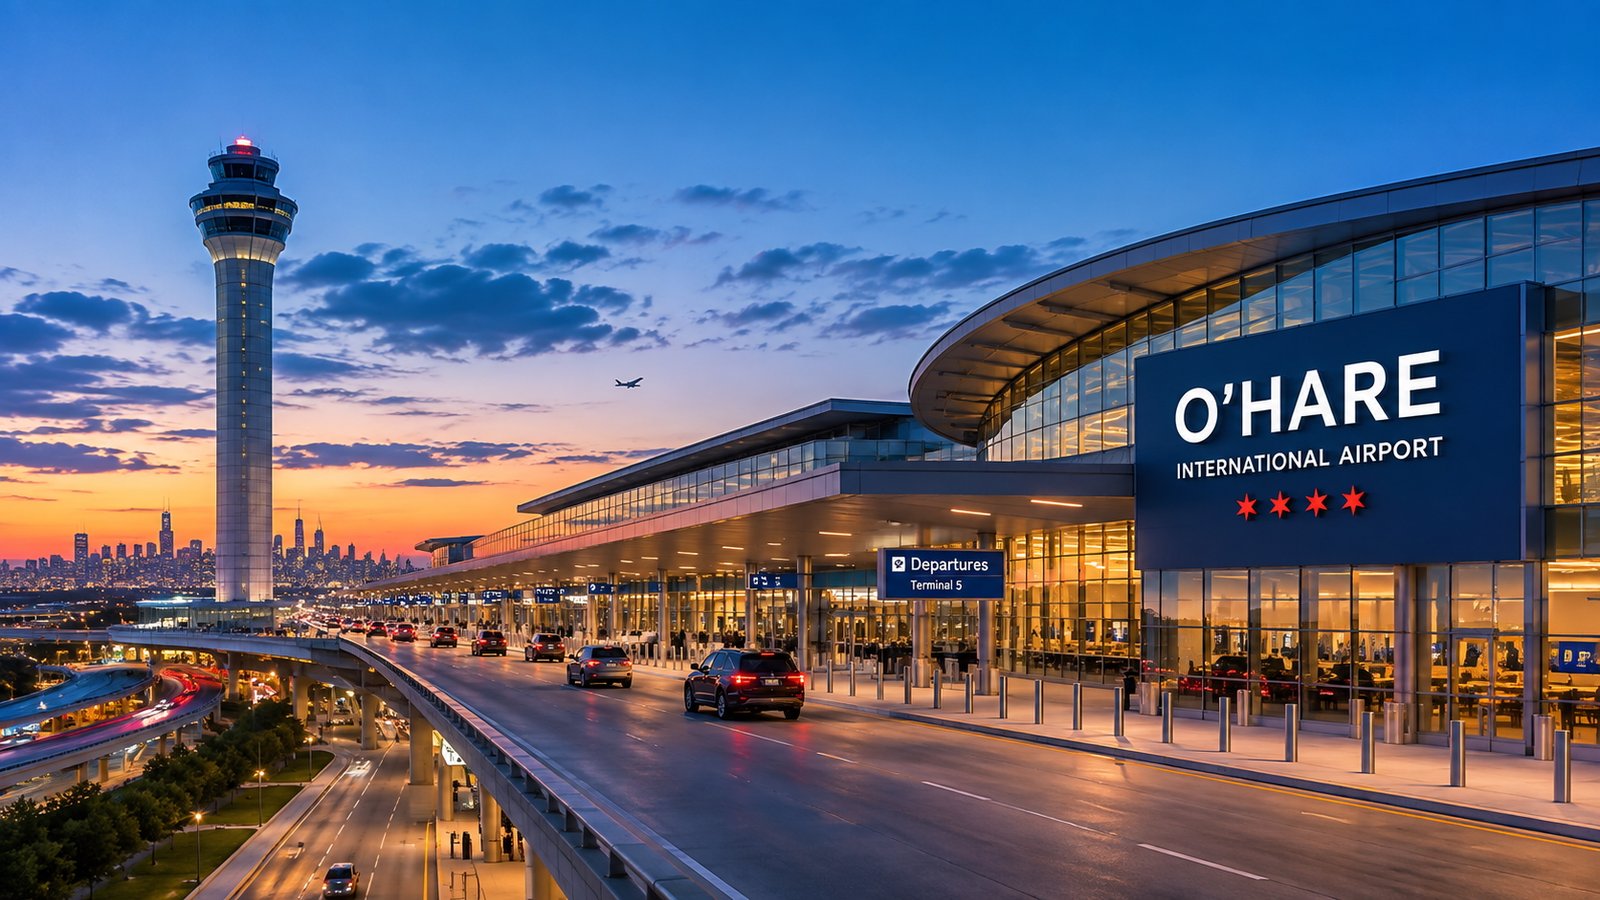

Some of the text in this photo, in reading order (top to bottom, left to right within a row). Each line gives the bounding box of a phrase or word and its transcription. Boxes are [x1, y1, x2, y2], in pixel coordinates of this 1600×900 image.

[1175, 349, 1440, 443] O'HARE
[1177, 436, 1443, 479] INTERNATIONAL AIRPORT
[911, 557, 989, 574] Departures
[910, 580, 963, 591] Terminal 5
